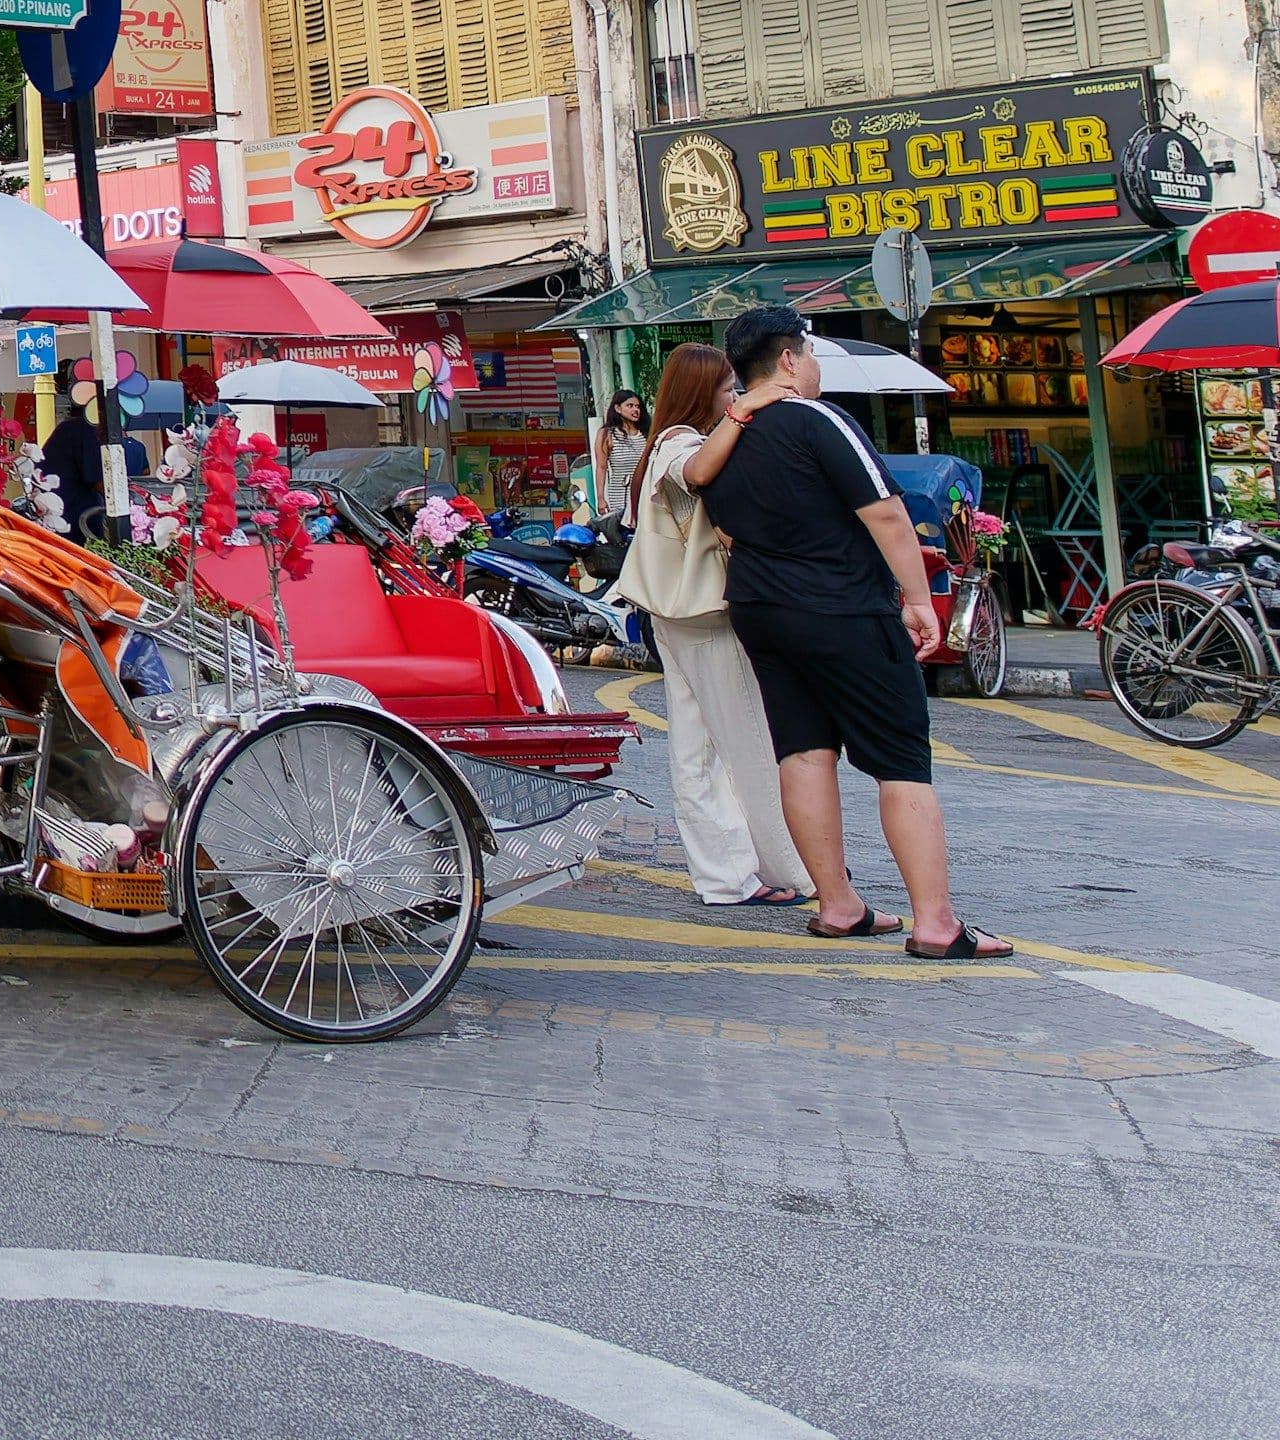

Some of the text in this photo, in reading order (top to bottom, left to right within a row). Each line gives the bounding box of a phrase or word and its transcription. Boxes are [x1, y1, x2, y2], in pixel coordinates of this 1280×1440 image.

[17, 2, 72, 18] P.PINANG
[118, 9, 182, 38] 24
[116, 72, 148, 86] 便利店
[125, 91, 201, 109] BUKA 24 JAM
[293, 120, 425, 189] 24
[668, 135, 728, 161] NASI KANDAR
[758, 115, 1114, 194] LINE CLEAR
[323, 169, 476, 205] XPRESS
[496, 174, 548, 198] 便利店
[1150, 169, 1208, 186] LINE CLEAR
[187, 194, 216, 205] hotlink
[1160, 182, 1200, 199] BISTRO
[676, 209, 729, 226] LINE CLEAR
[827, 177, 1040, 239] BISTRO
[113, 206, 182, 242] DOTS
[285, 342, 428, 361] INTERNET TANPA HA
[285, 432, 318, 443] AGUH
